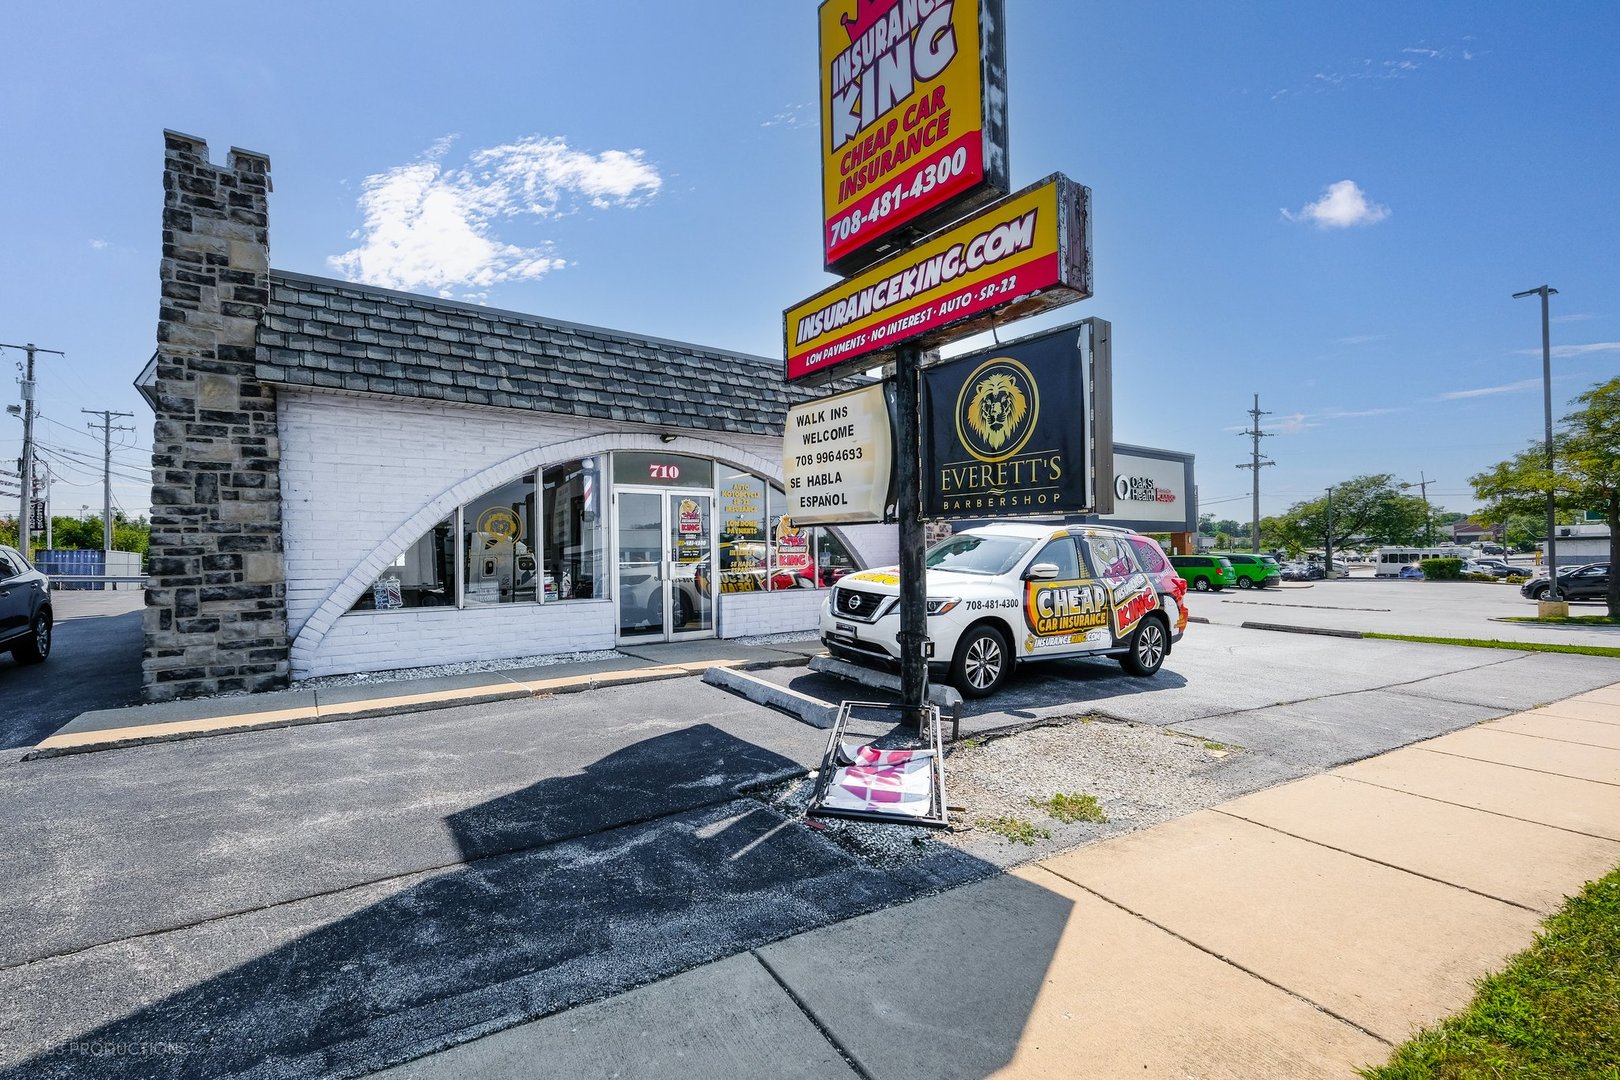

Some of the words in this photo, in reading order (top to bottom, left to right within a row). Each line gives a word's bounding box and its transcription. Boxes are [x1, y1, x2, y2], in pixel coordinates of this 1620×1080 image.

[833, 0, 949, 93] INSURANC
[832, 3, 957, 151] KING
[840, 118, 898, 176] CHEAP
[903, 85, 946, 132] CAR
[838, 109, 951, 204] INSURANCE
[830, 146, 967, 247] 708-481-4300
[795, 207, 1038, 347] INSURANCEKING.COM
[806, 351, 822, 366] LOW
[822, 337, 866, 360] PAYMENTS
[871, 326, 886, 340] NO
[887, 308, 932, 335] INTEREST
[938, 293, 972, 316] AUTO
[979, 275, 1017, 301] SR-22
[796, 410, 825, 427] WALK
[830, 406, 848, 420] INS
[803, 424, 854, 445] WELCOME
[796, 454, 813, 467] 708
[816, 447, 863, 464] 9964693
[649, 464, 679, 479] 710
[790, 477, 801, 488] SE
[807, 471, 842, 487] HABLA
[941, 455, 1062, 491] EVERETT'S
[800, 492, 848, 508] ESPAÑOL
[943, 494, 1061, 510] BARBERSHOP
[779, 554, 806, 566] KING
[966, 598, 1019, 611] 708-481-4300
[1037, 586, 1106, 618] CHEAP
[1117, 587, 1155, 630] KING
[1039, 617, 1058, 632] CAR
[1060, 612, 1106, 631] INSURANCE
